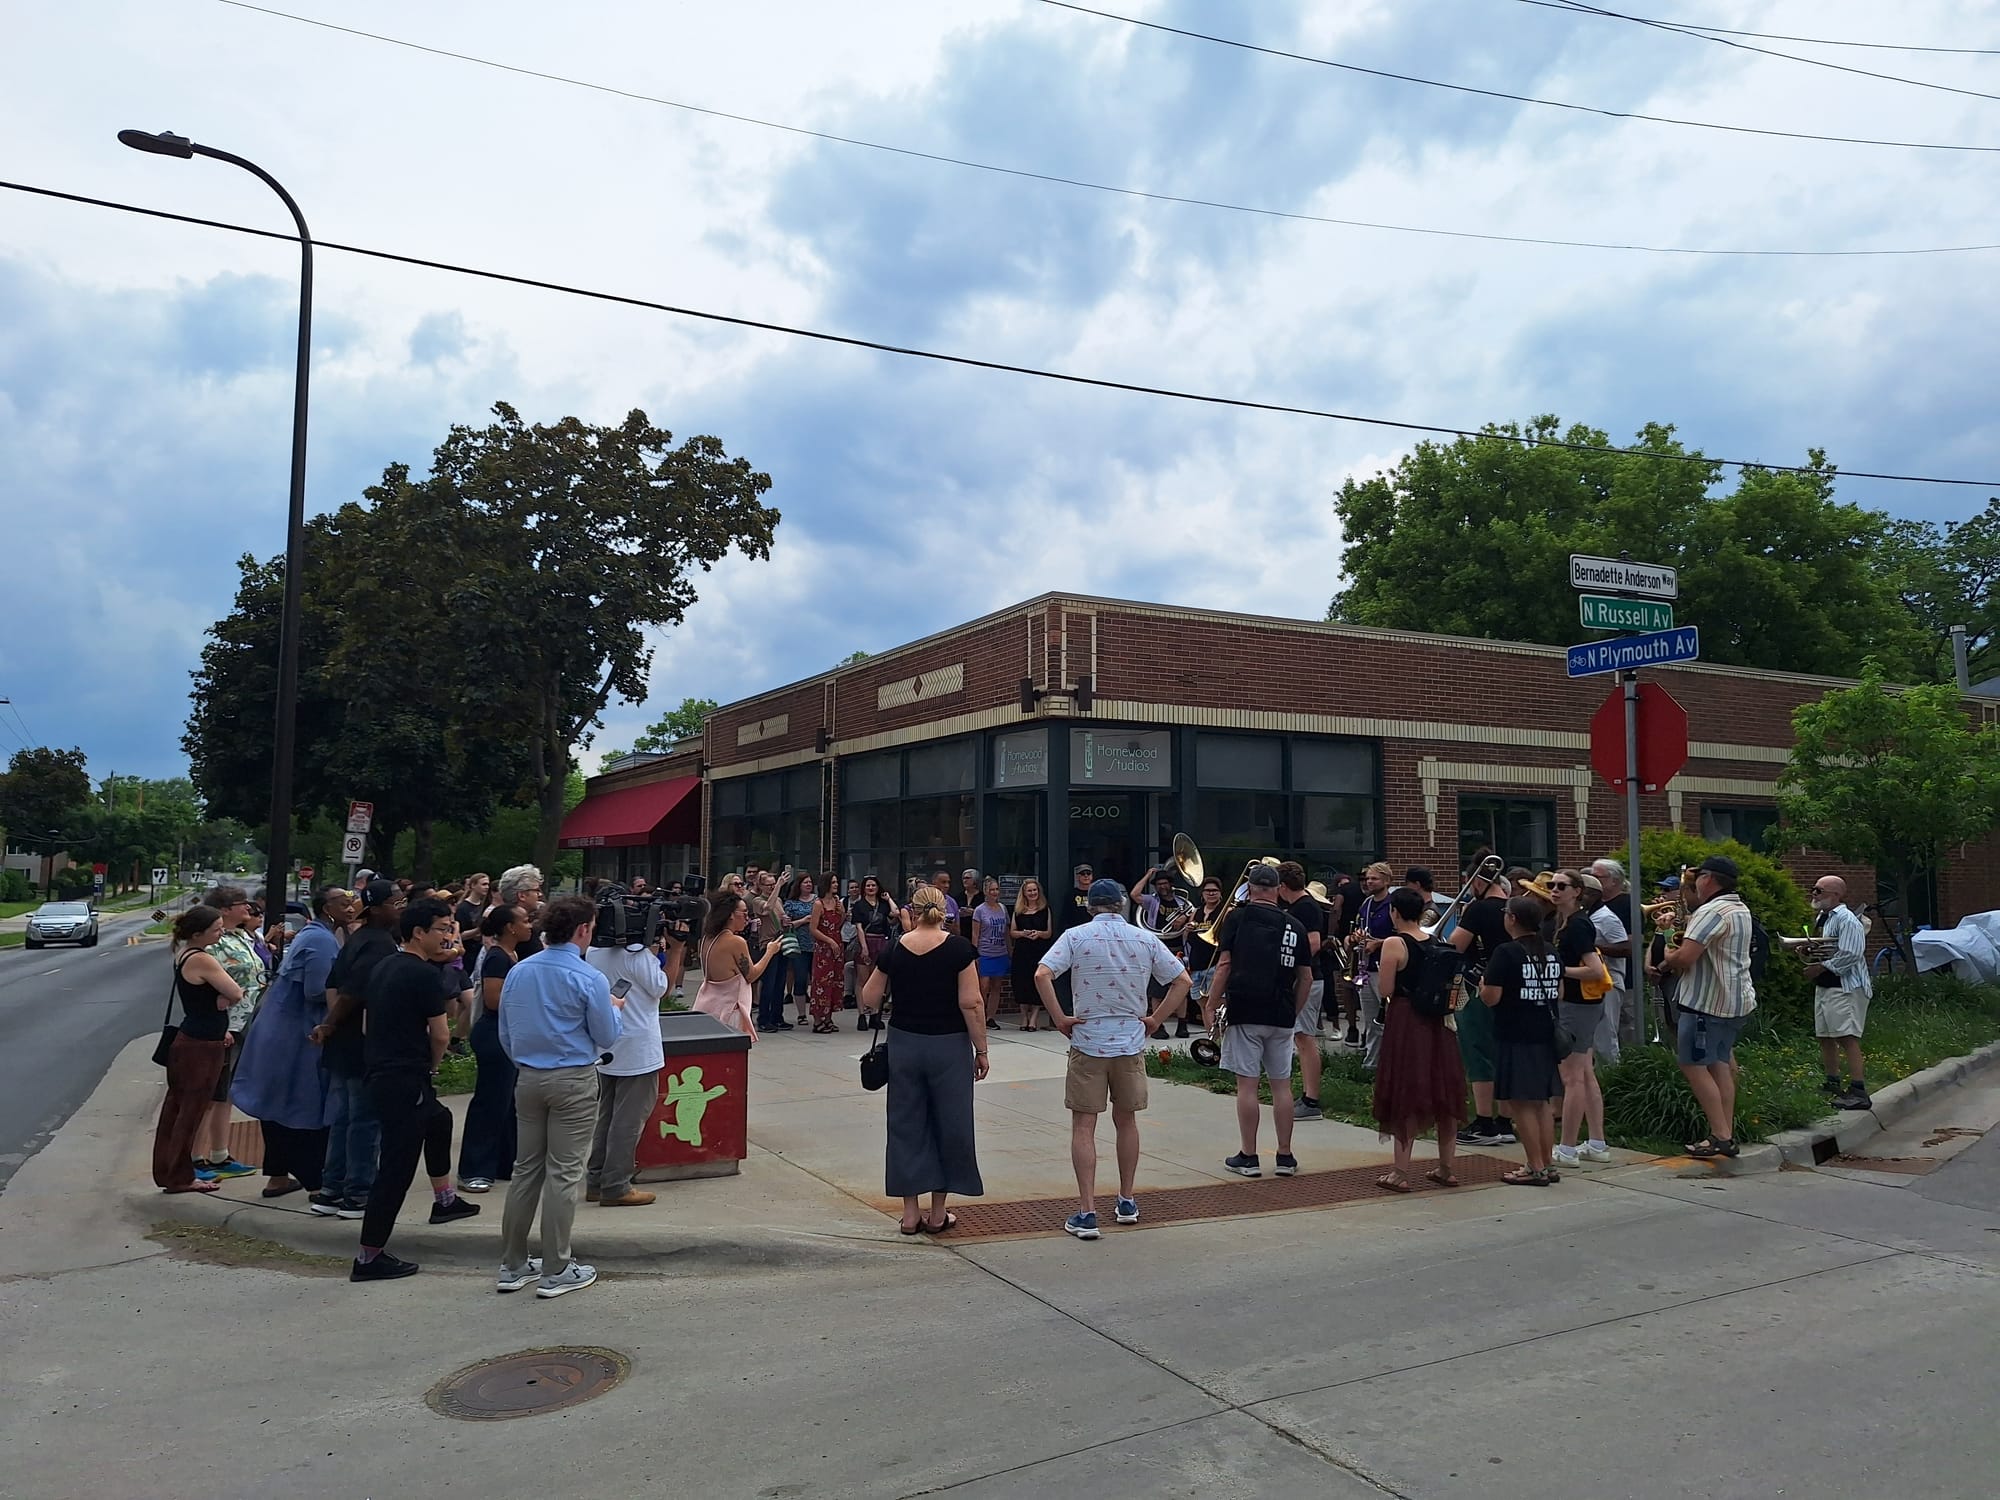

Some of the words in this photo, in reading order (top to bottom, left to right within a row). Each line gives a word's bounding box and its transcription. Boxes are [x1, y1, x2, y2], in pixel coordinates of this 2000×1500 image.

[1574, 562, 1623, 585] Bernadette
[1624, 568, 1661, 590] Anderson
[1661, 573, 1674, 589] Way
[1583, 601, 1593, 622] N
[1598, 603, 1648, 626] Russell
[1653, 608, 1670, 628] Av
[1587, 649, 1596, 668] N
[1600, 638, 1669, 667] Plymouth
[1675, 634, 1695, 655] Av
[1007, 747, 1042, 761] Homewood
[1097, 743, 1158, 759] Homewood
[1011, 762, 1038, 776] Studios
[1106, 758, 1150, 772] Studios
[1070, 805, 1120, 819] 2400
